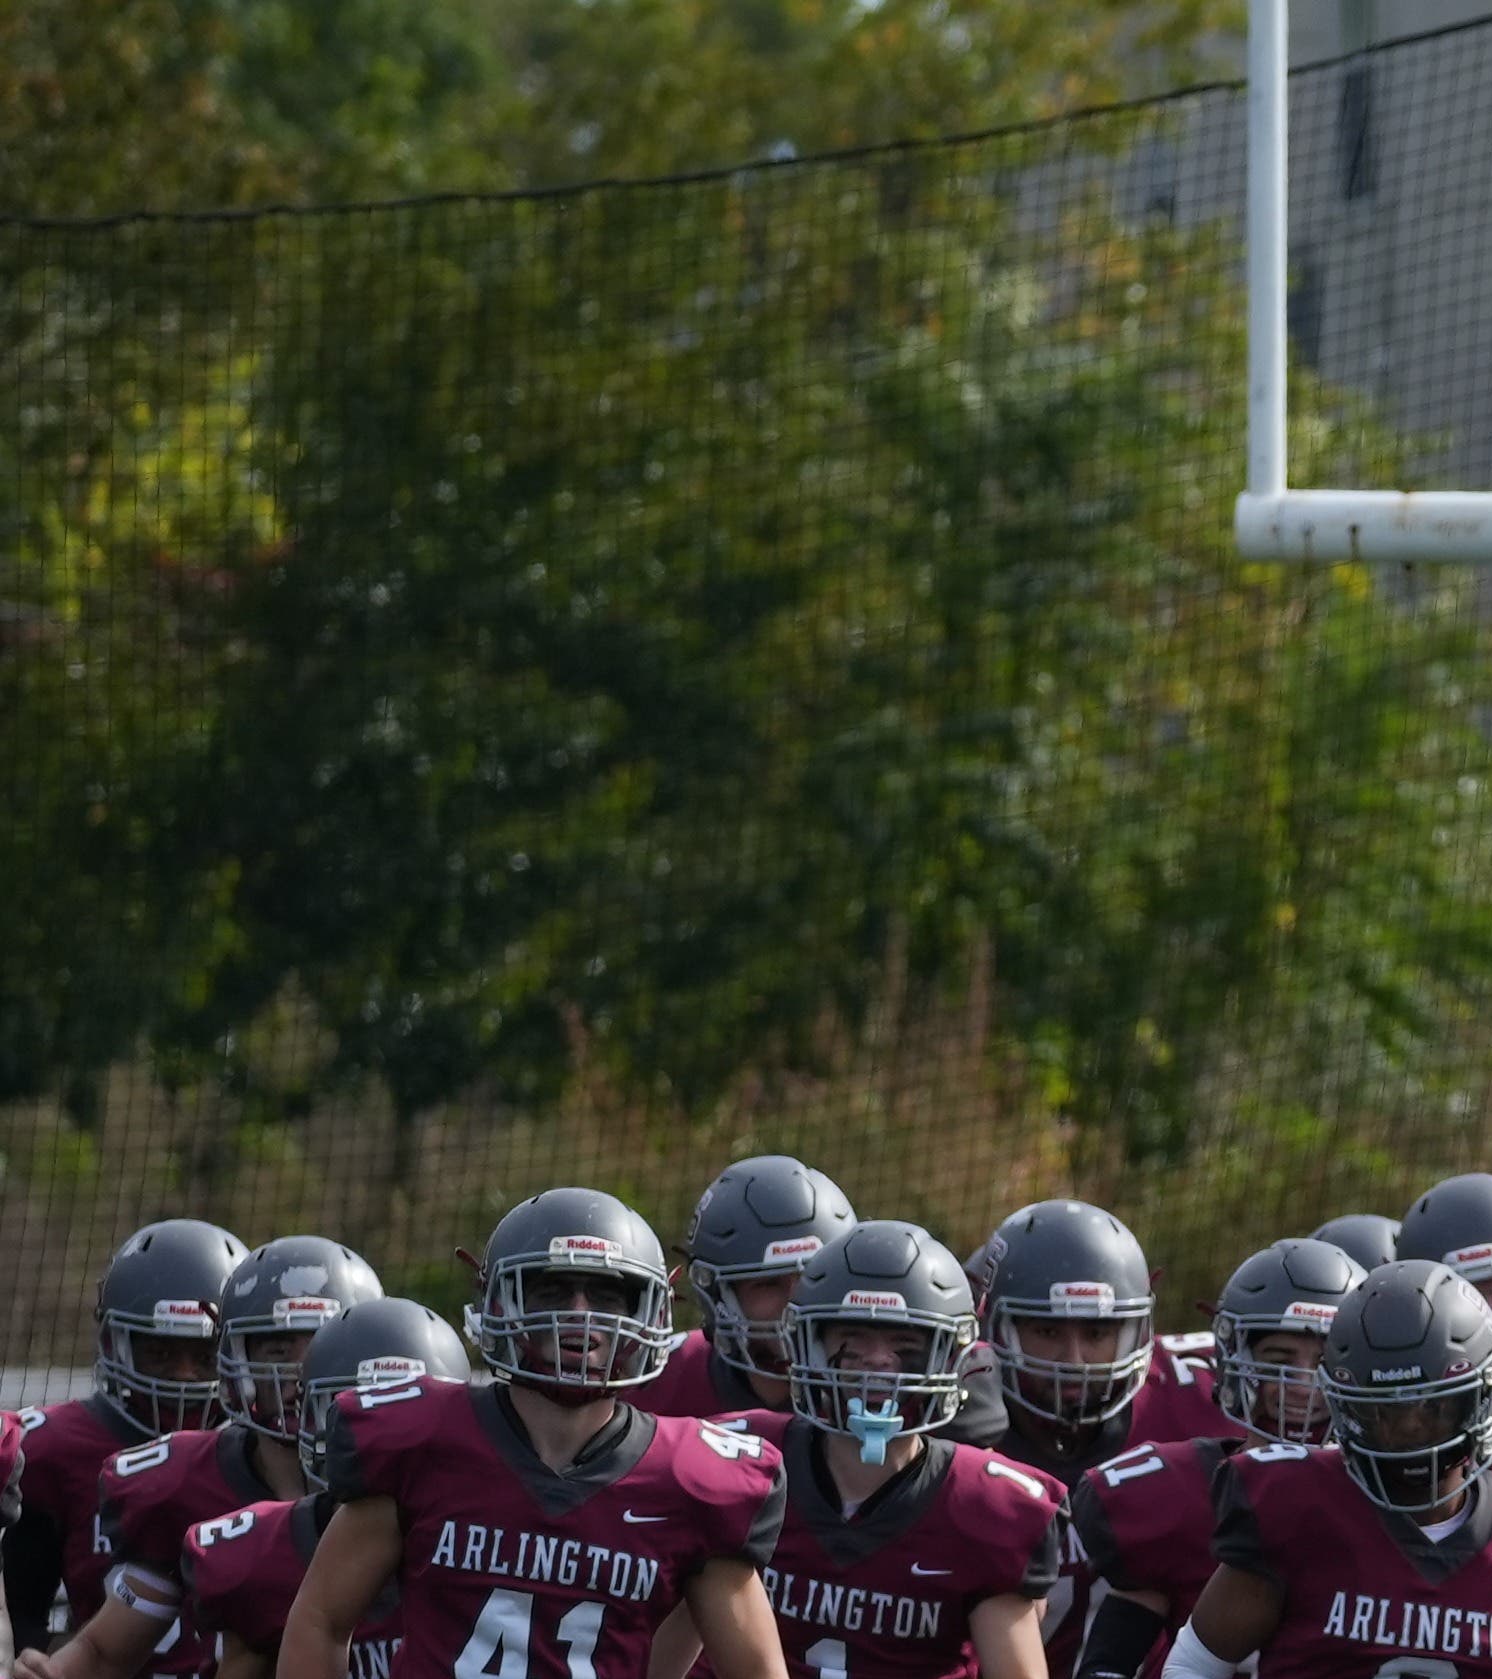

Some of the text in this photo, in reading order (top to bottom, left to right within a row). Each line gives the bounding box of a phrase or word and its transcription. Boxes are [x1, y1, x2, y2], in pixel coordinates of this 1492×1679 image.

[567, 1239, 606, 1252] Riddell
[288, 1302, 325, 1311] Riddell
[849, 1294, 897, 1307] Riddell
[373, 1361, 409, 1371] Riddell
[1372, 1366, 1421, 1382] Riddell
[115, 1433, 172, 1478] 0
[986, 1460, 1047, 1500] 1
[430, 1520, 660, 1602] ARLINGTON
